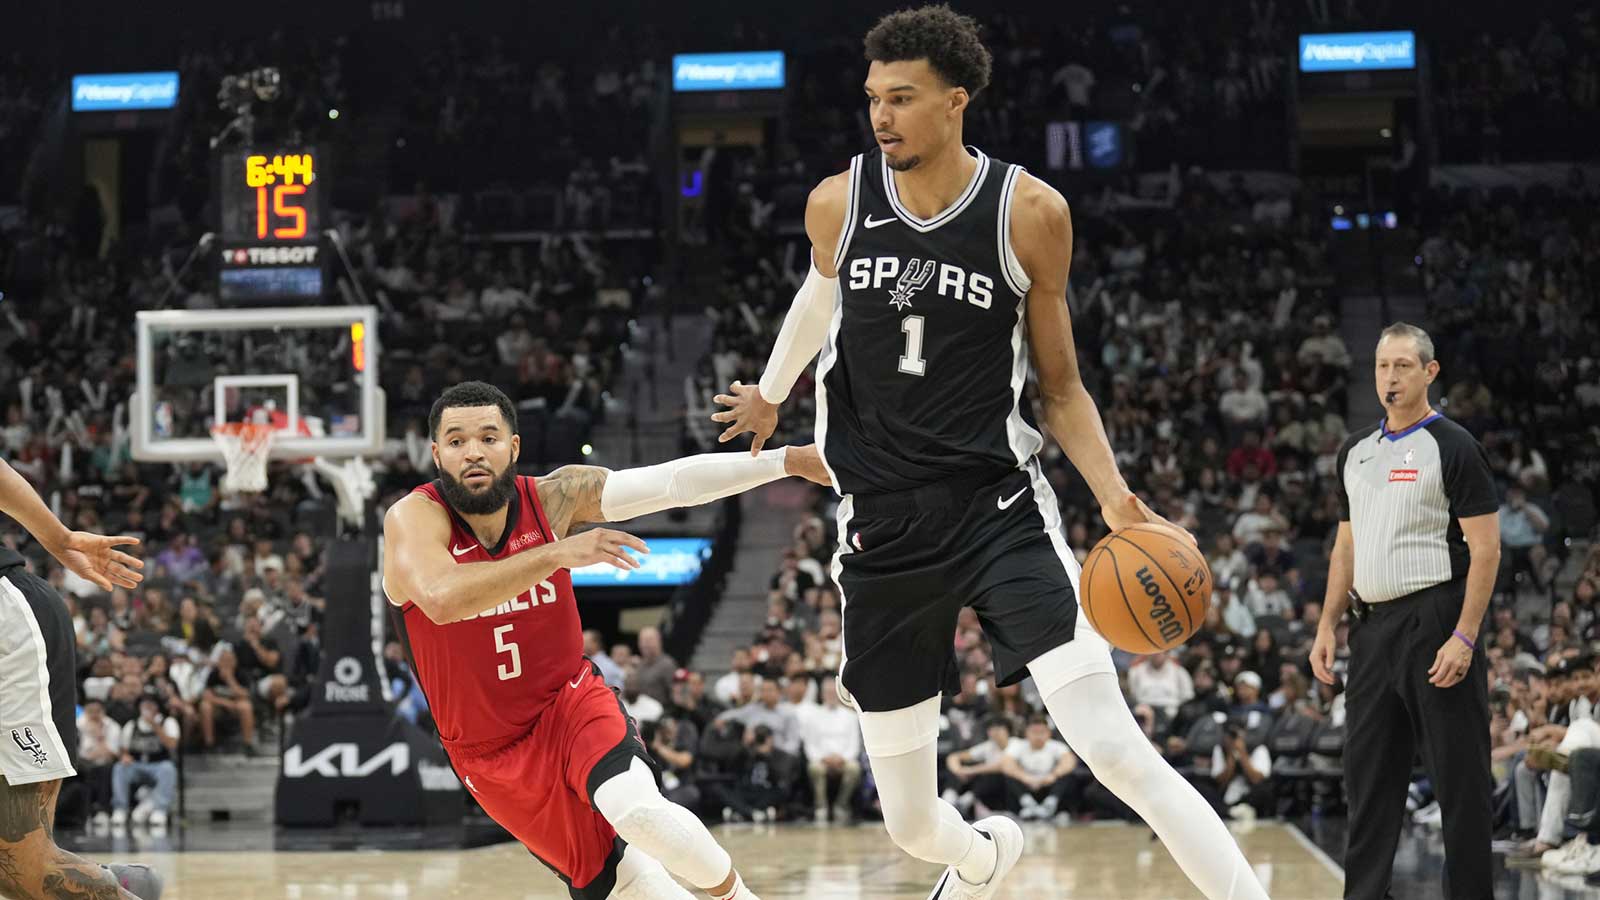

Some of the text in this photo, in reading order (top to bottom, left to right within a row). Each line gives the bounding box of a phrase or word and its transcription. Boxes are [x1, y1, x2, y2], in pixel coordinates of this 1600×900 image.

[246, 154, 313, 187] 6:44
[257, 184, 307, 240] 15
[248, 246, 318, 264] TISSOT
[898, 314, 927, 377] 1
[1136, 565, 1184, 643] Wilson
[493, 623, 522, 681] 5
[283, 742, 410, 777] KIA
